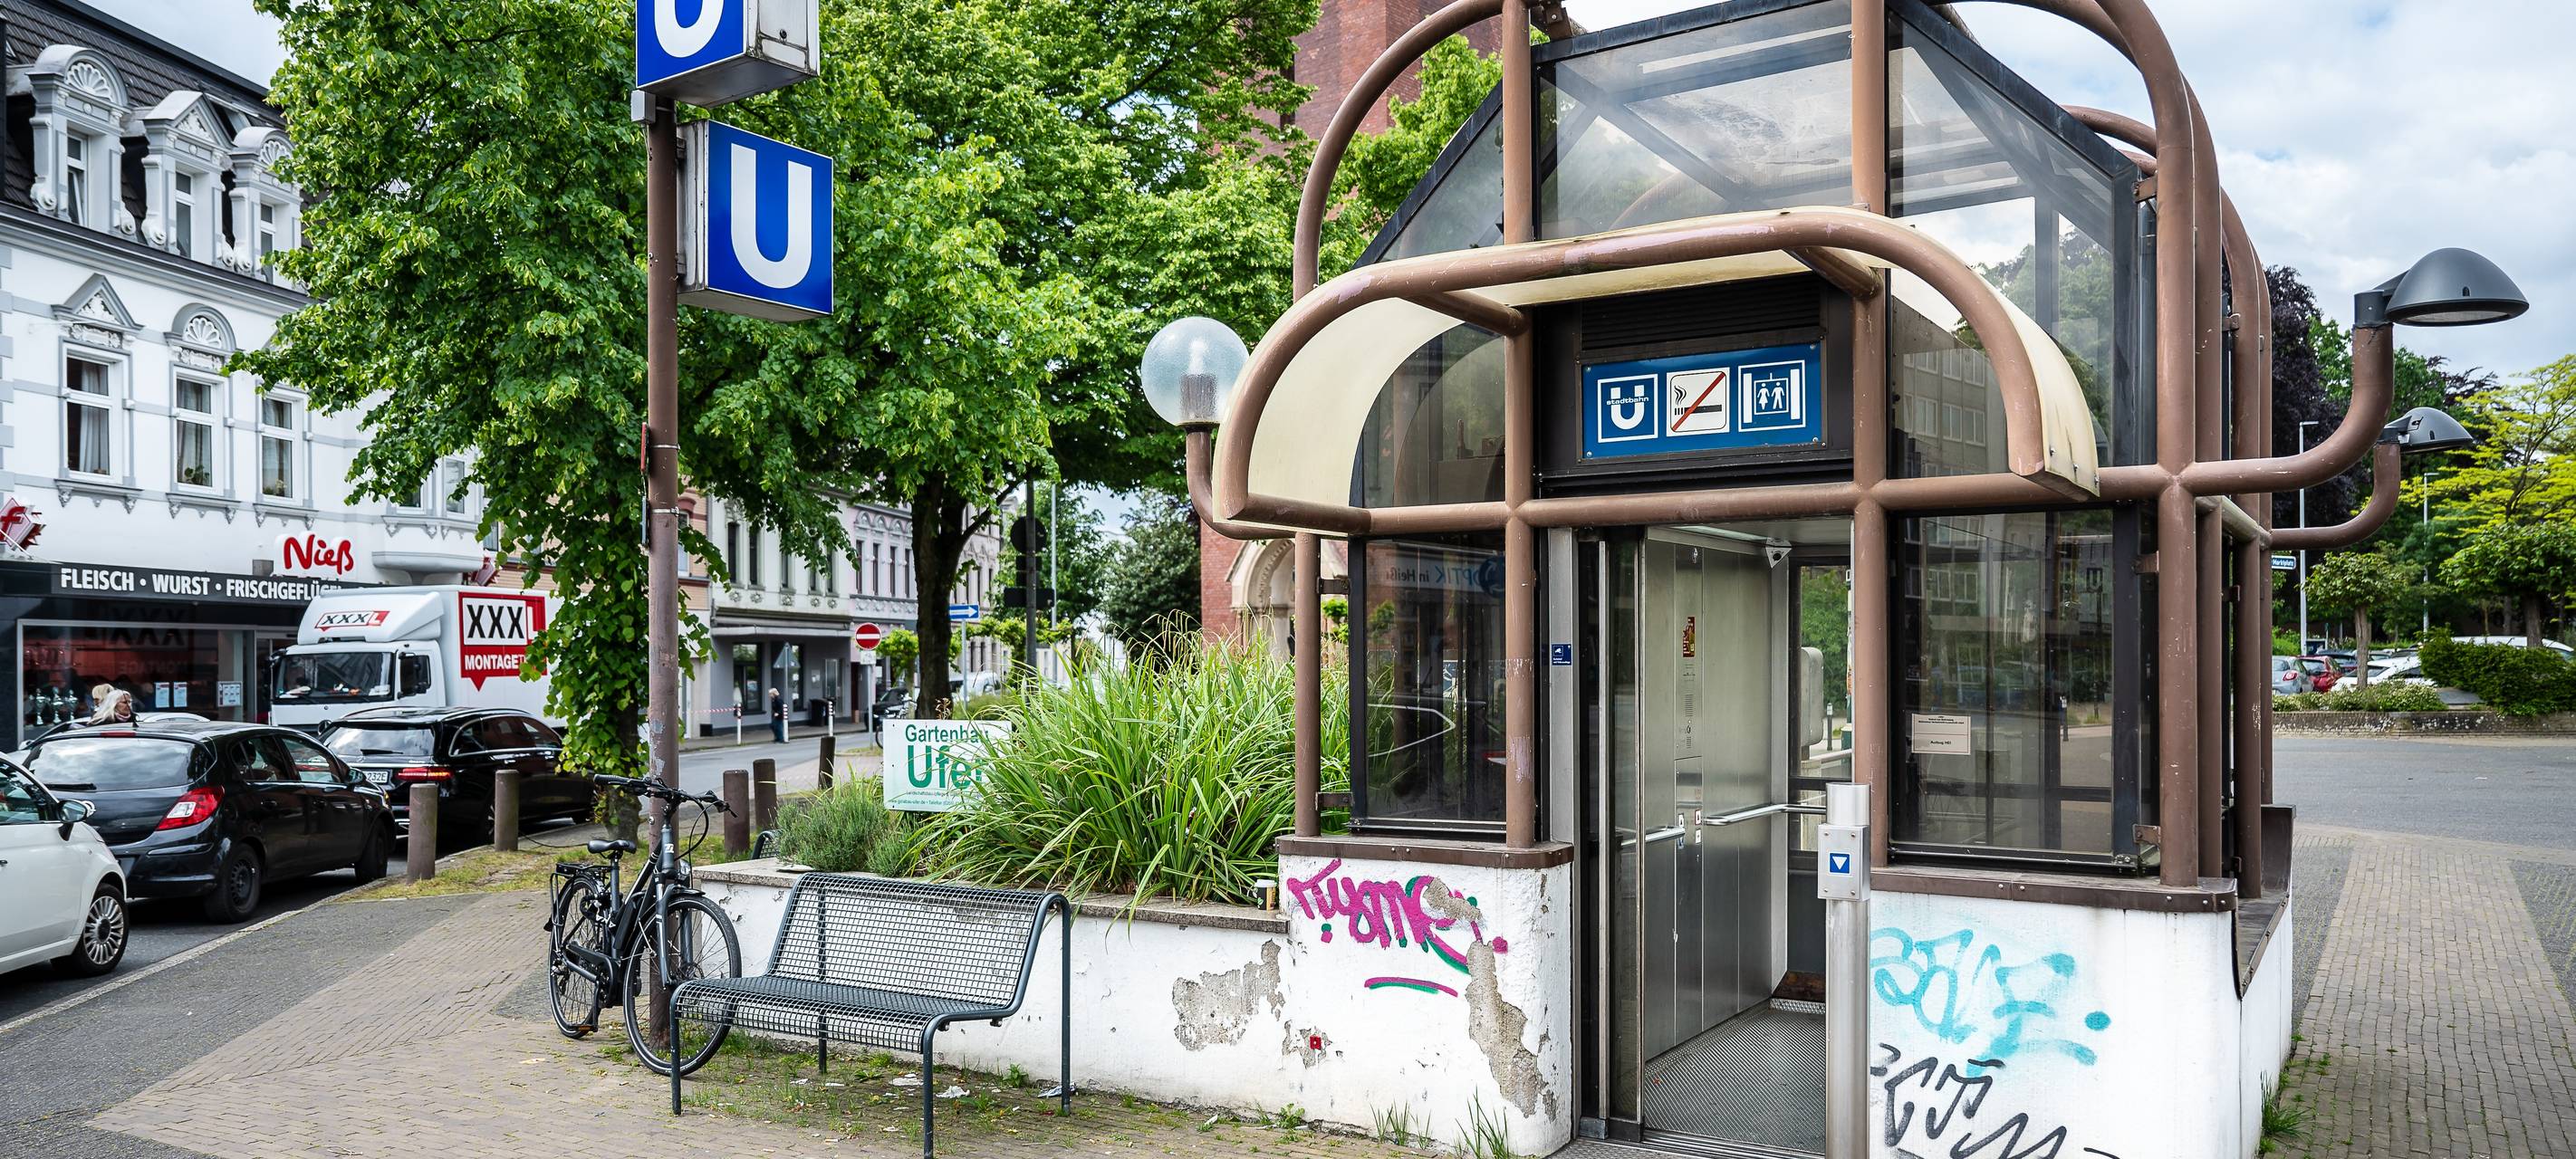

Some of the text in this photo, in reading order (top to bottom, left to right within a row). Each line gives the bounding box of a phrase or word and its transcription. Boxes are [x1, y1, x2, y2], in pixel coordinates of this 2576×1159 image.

[731, 142, 812, 290] U
[1606, 396, 1649, 406] stadtbahn
[283, 533, 354, 575] Nieß
[61, 568, 135, 591] FLEISCH
[152, 573, 210, 595] WURST
